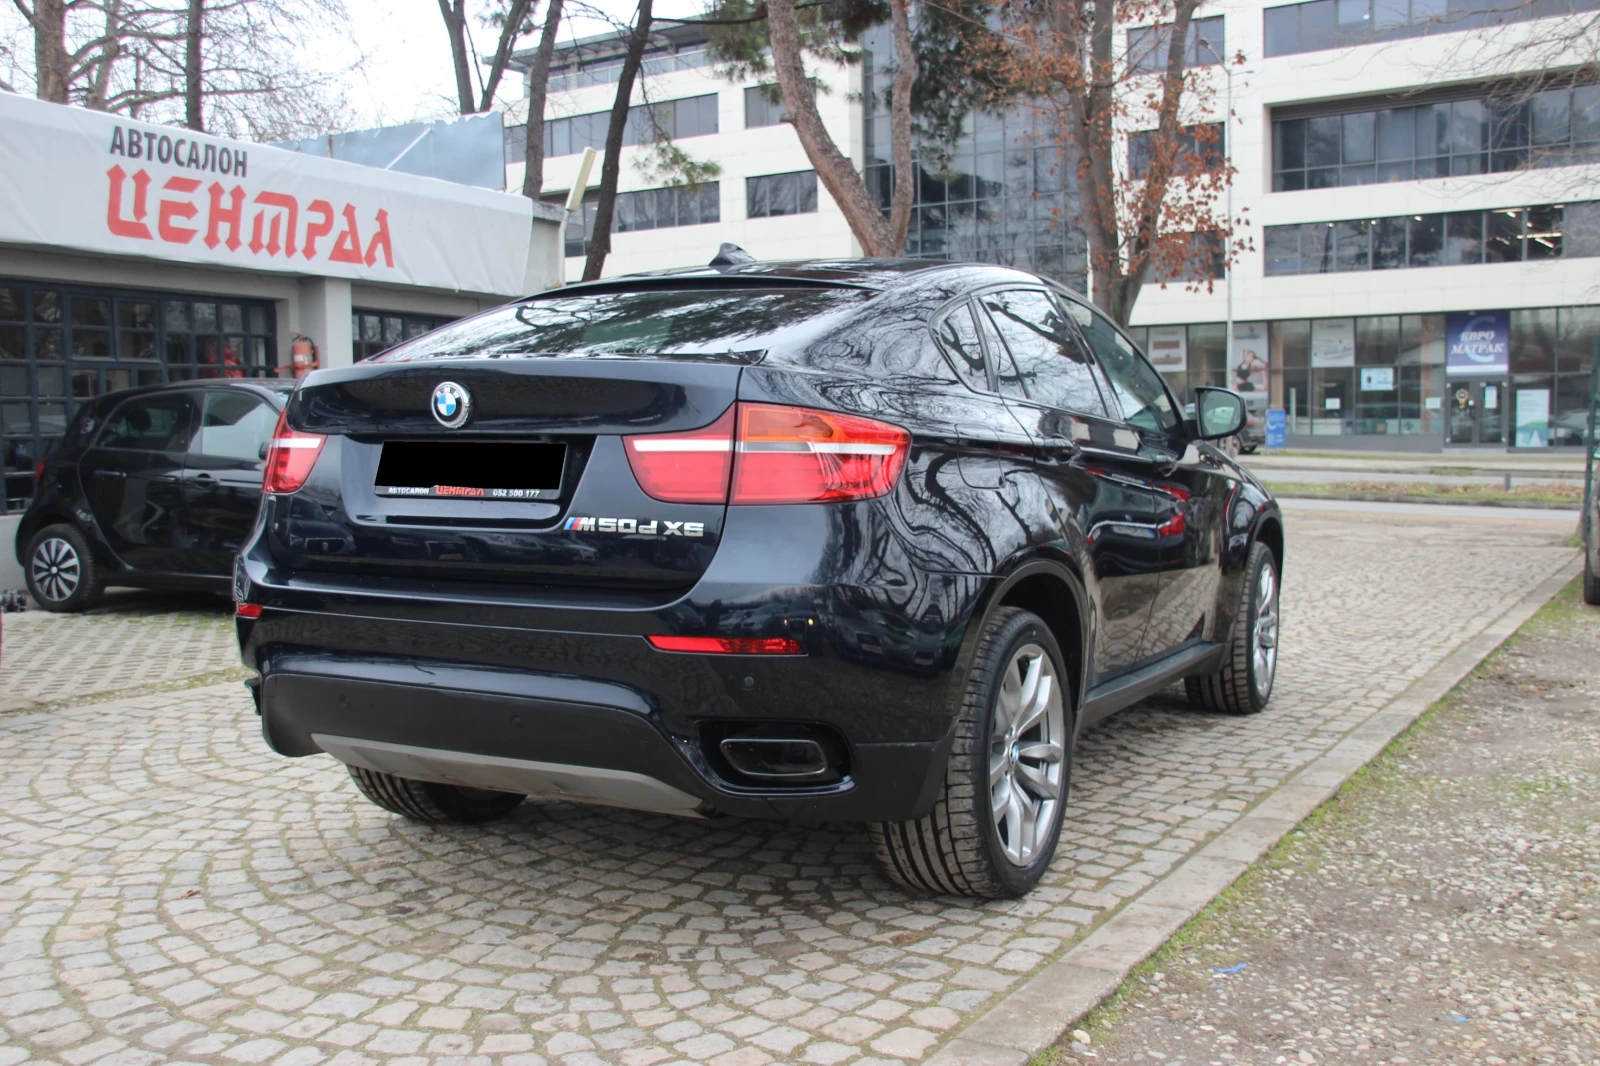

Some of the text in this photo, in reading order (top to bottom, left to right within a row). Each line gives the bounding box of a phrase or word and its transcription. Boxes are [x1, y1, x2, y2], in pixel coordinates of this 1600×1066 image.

[109, 125, 248, 178] АВТОСАЛОН
[106, 163, 395, 269] ЦЕНТРАЛ
[1460, 330, 1496, 342] ЕВРО
[1451, 343, 1505, 355] МАТРАК
[388, 487, 430, 495] АВТОСАЛОН
[492, 488, 507, 497] 052
[508, 489, 524, 497] 500
[525, 489, 540, 498] 177
[663, 521, 704, 537] X6
